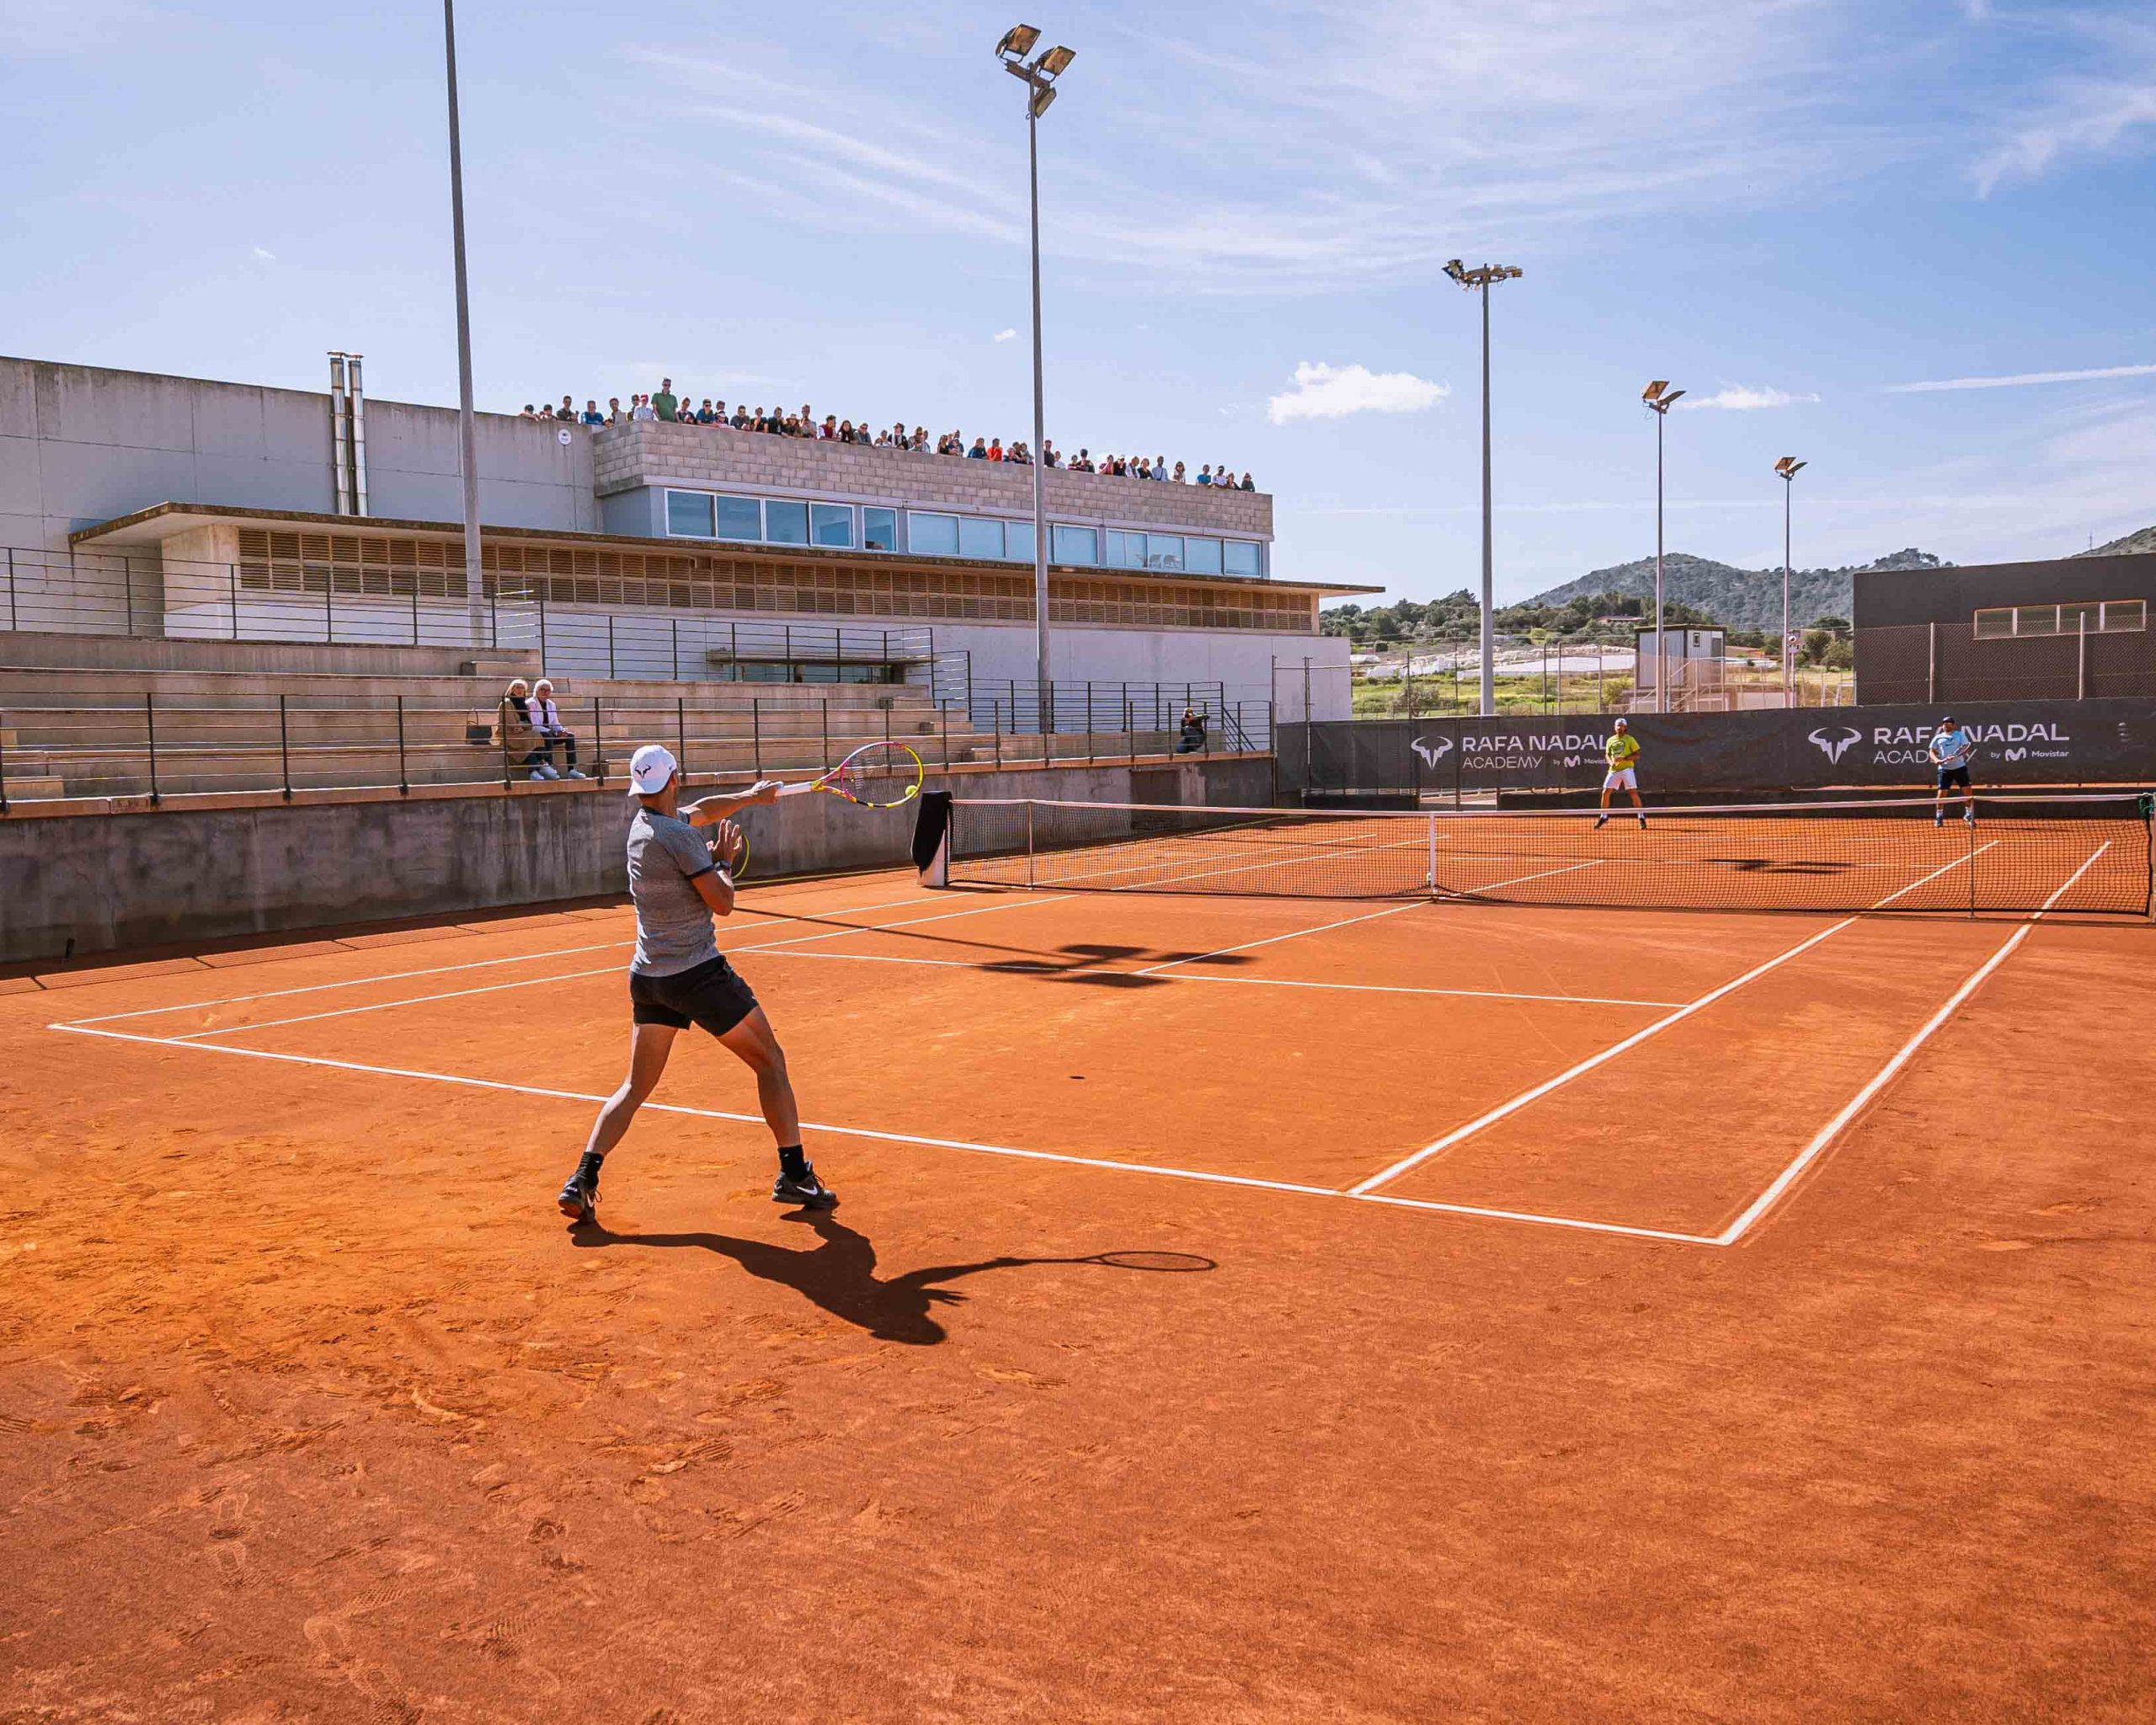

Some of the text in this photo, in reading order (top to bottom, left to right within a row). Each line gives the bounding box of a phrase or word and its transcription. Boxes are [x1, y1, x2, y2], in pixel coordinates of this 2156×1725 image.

[1961, 724, 2070, 742] NADAL
[1462, 734, 1606, 751] RAFA NADAL
[1462, 756, 1543, 768] ACADEMY
[1873, 748, 1978, 764] ACADY
[1990, 750, 2000, 760] by
[2031, 750, 2069, 758] Movistar
